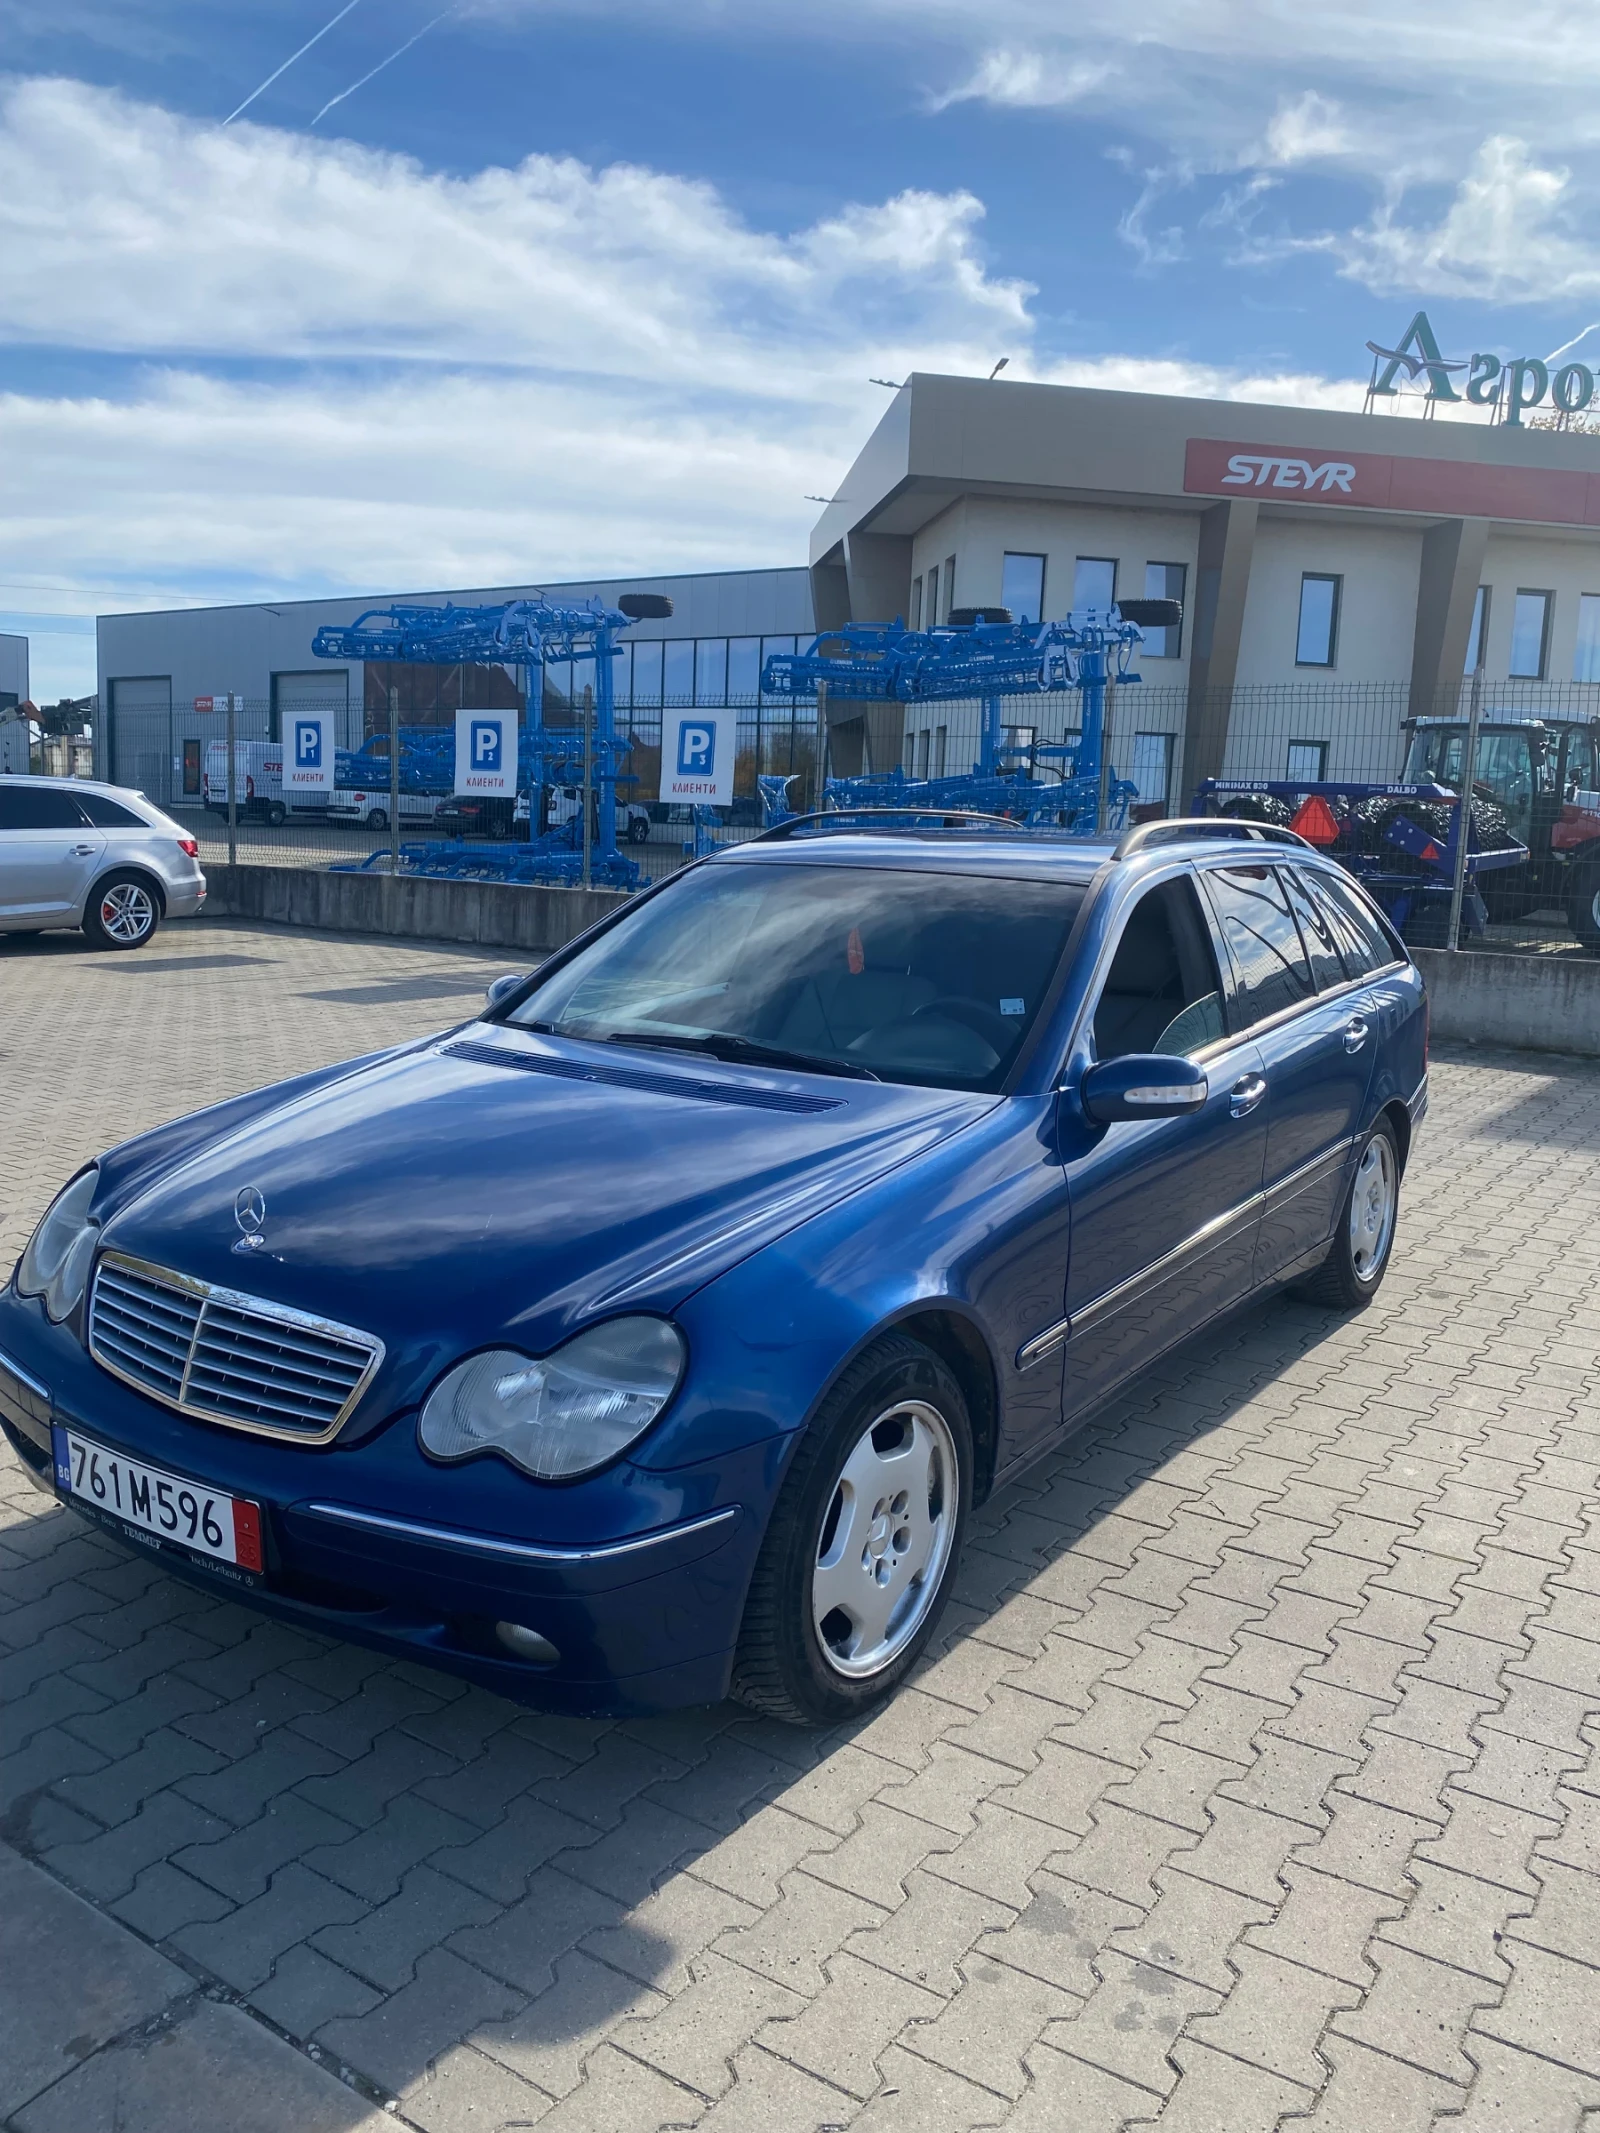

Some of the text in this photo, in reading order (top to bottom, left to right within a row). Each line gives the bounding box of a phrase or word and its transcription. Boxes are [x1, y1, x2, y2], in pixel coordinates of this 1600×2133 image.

[1221, 454, 1357, 493] STEYR
[292, 773, 324, 782] КЛИЕНТИ
[466, 777, 504, 788] КЛИЕНТИ
[672, 782, 716, 795] КЛИЕНТИ
[1387, 786, 1417, 794] DALBO
[58, 1464, 70, 1481] BG
